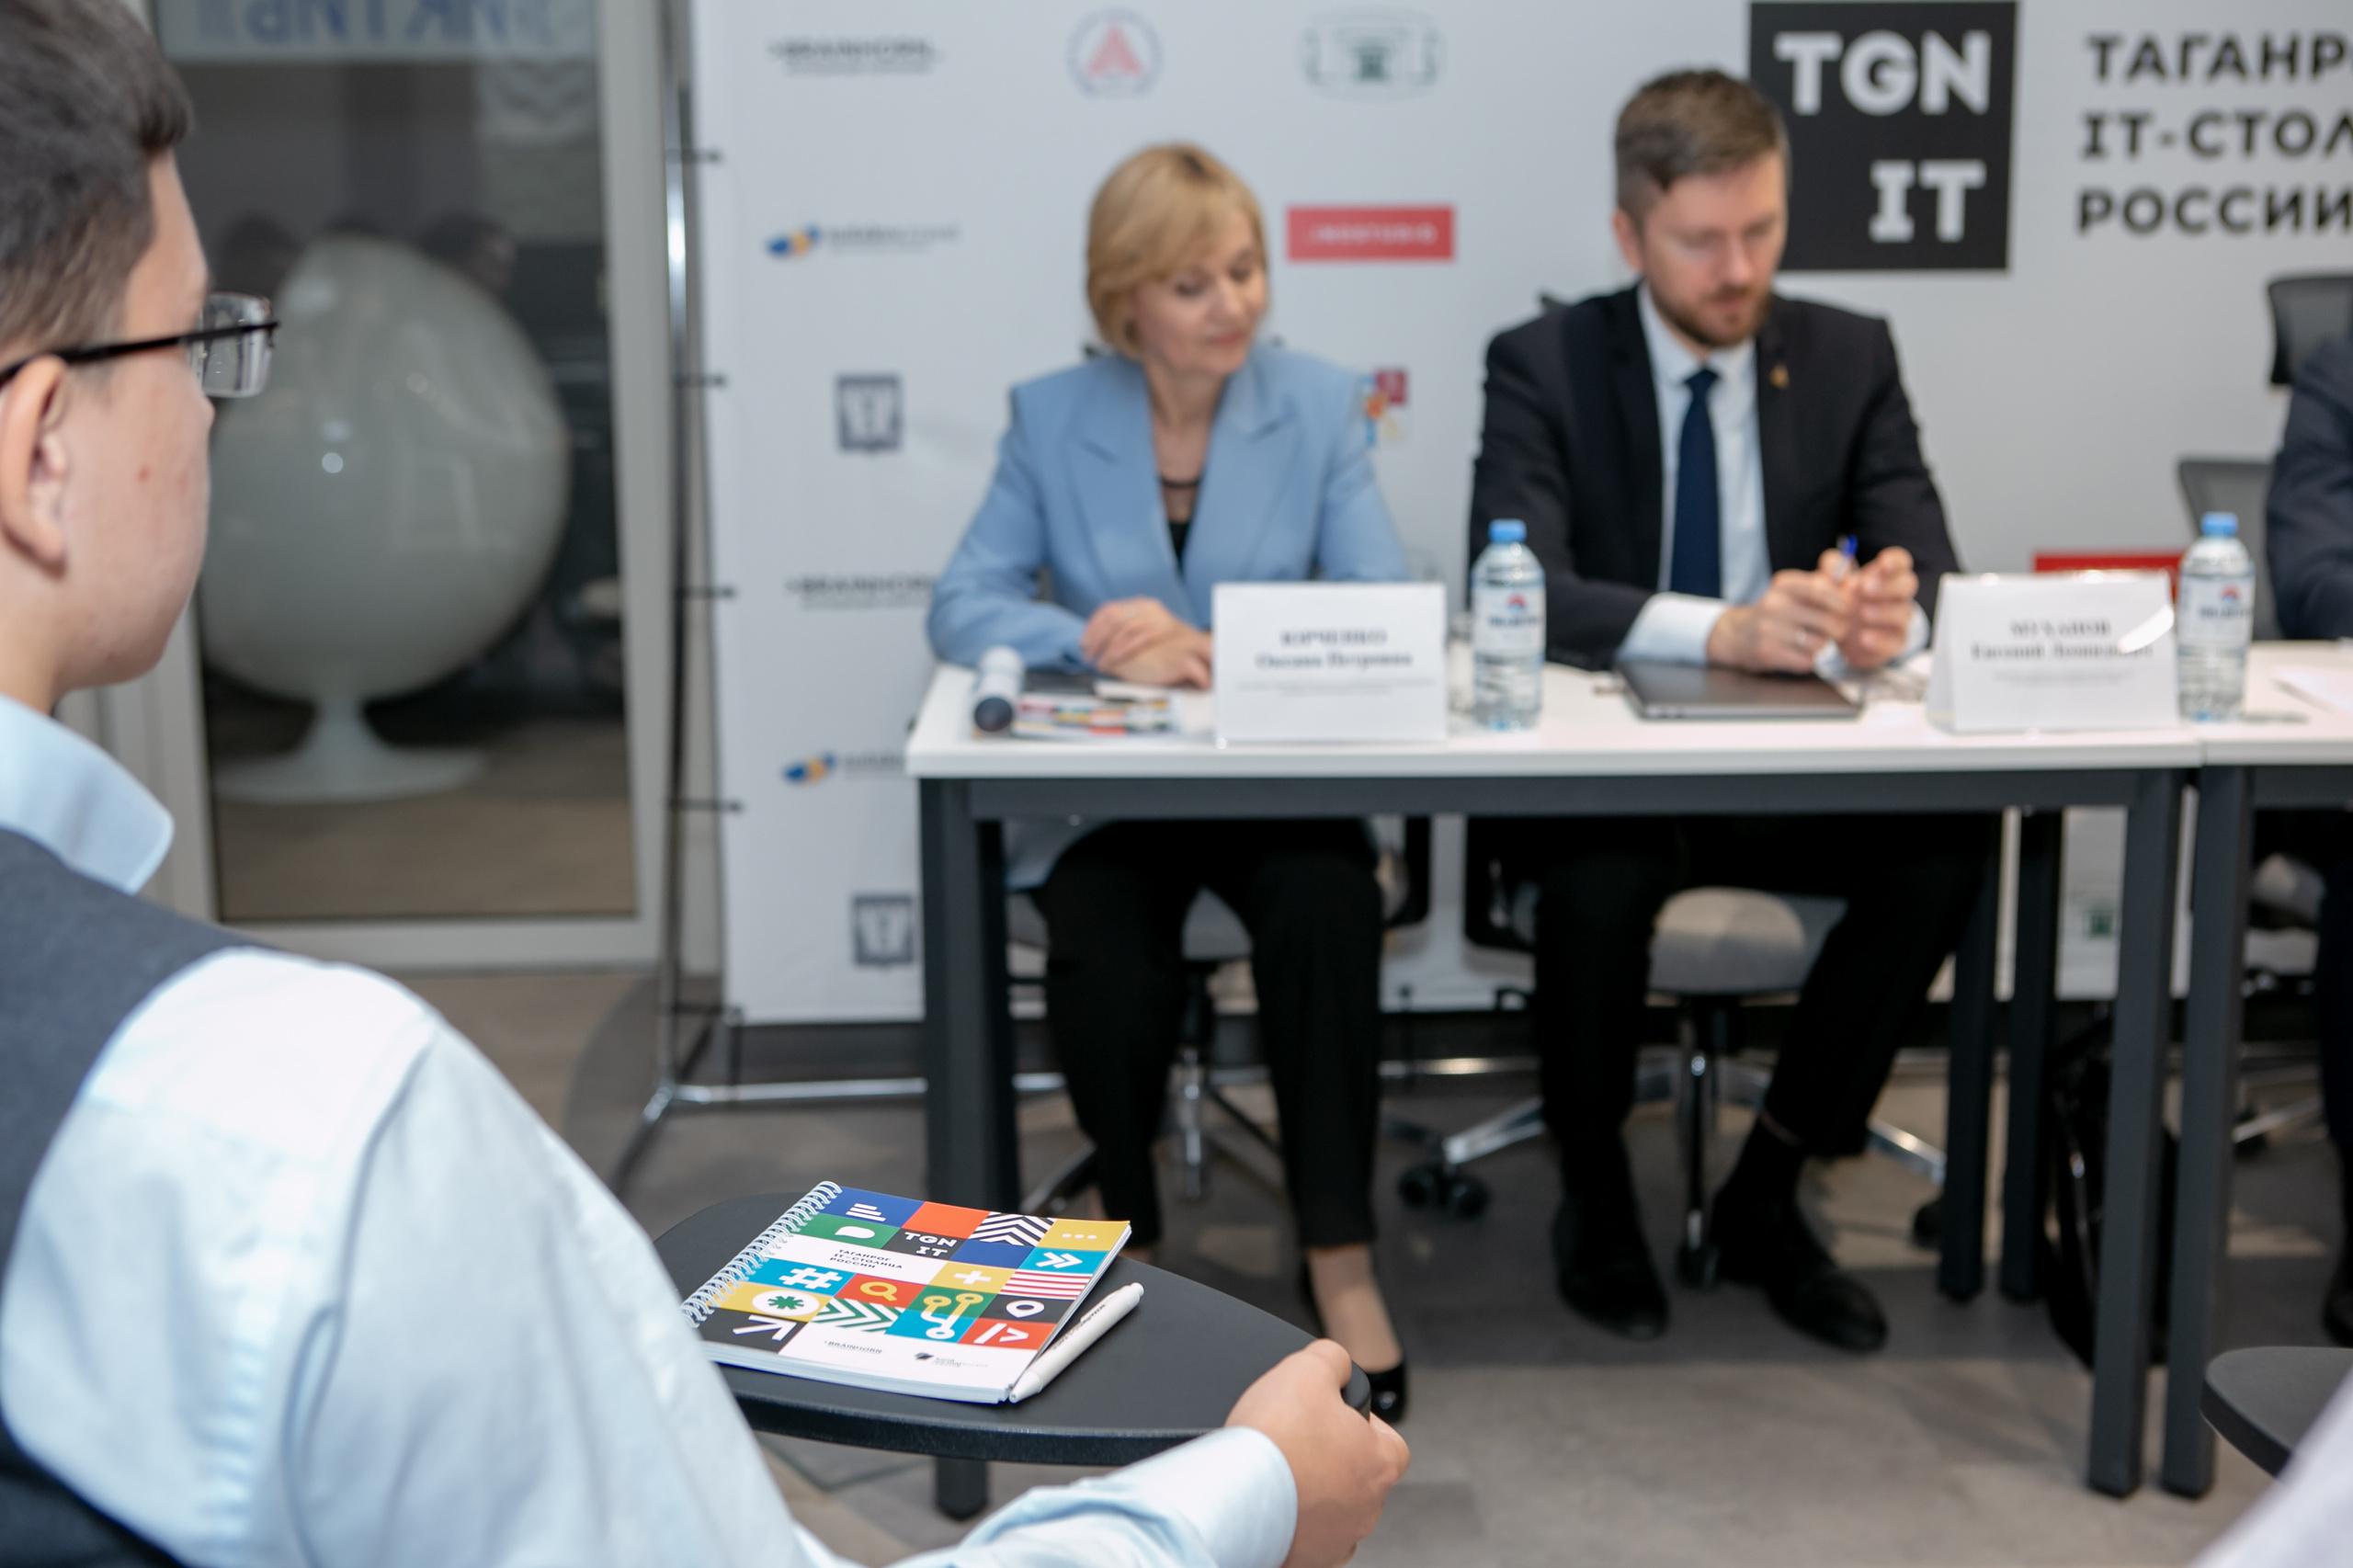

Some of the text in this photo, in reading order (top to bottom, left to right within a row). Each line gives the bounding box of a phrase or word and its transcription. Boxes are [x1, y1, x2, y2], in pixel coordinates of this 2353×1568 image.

[2087, 34, 2353, 81] ТАГАНР
[1774, 31, 1991, 116] TGN
[1869, 160, 1986, 242] IT
[2077, 187, 2353, 236] РОССИИ
[838, 1249, 892, 1261] ТАГАНРОГ
[904, 1232, 958, 1247] TGN
[915, 1245, 949, 1257] IT
[829, 1257, 876, 1268] РОССИИ
